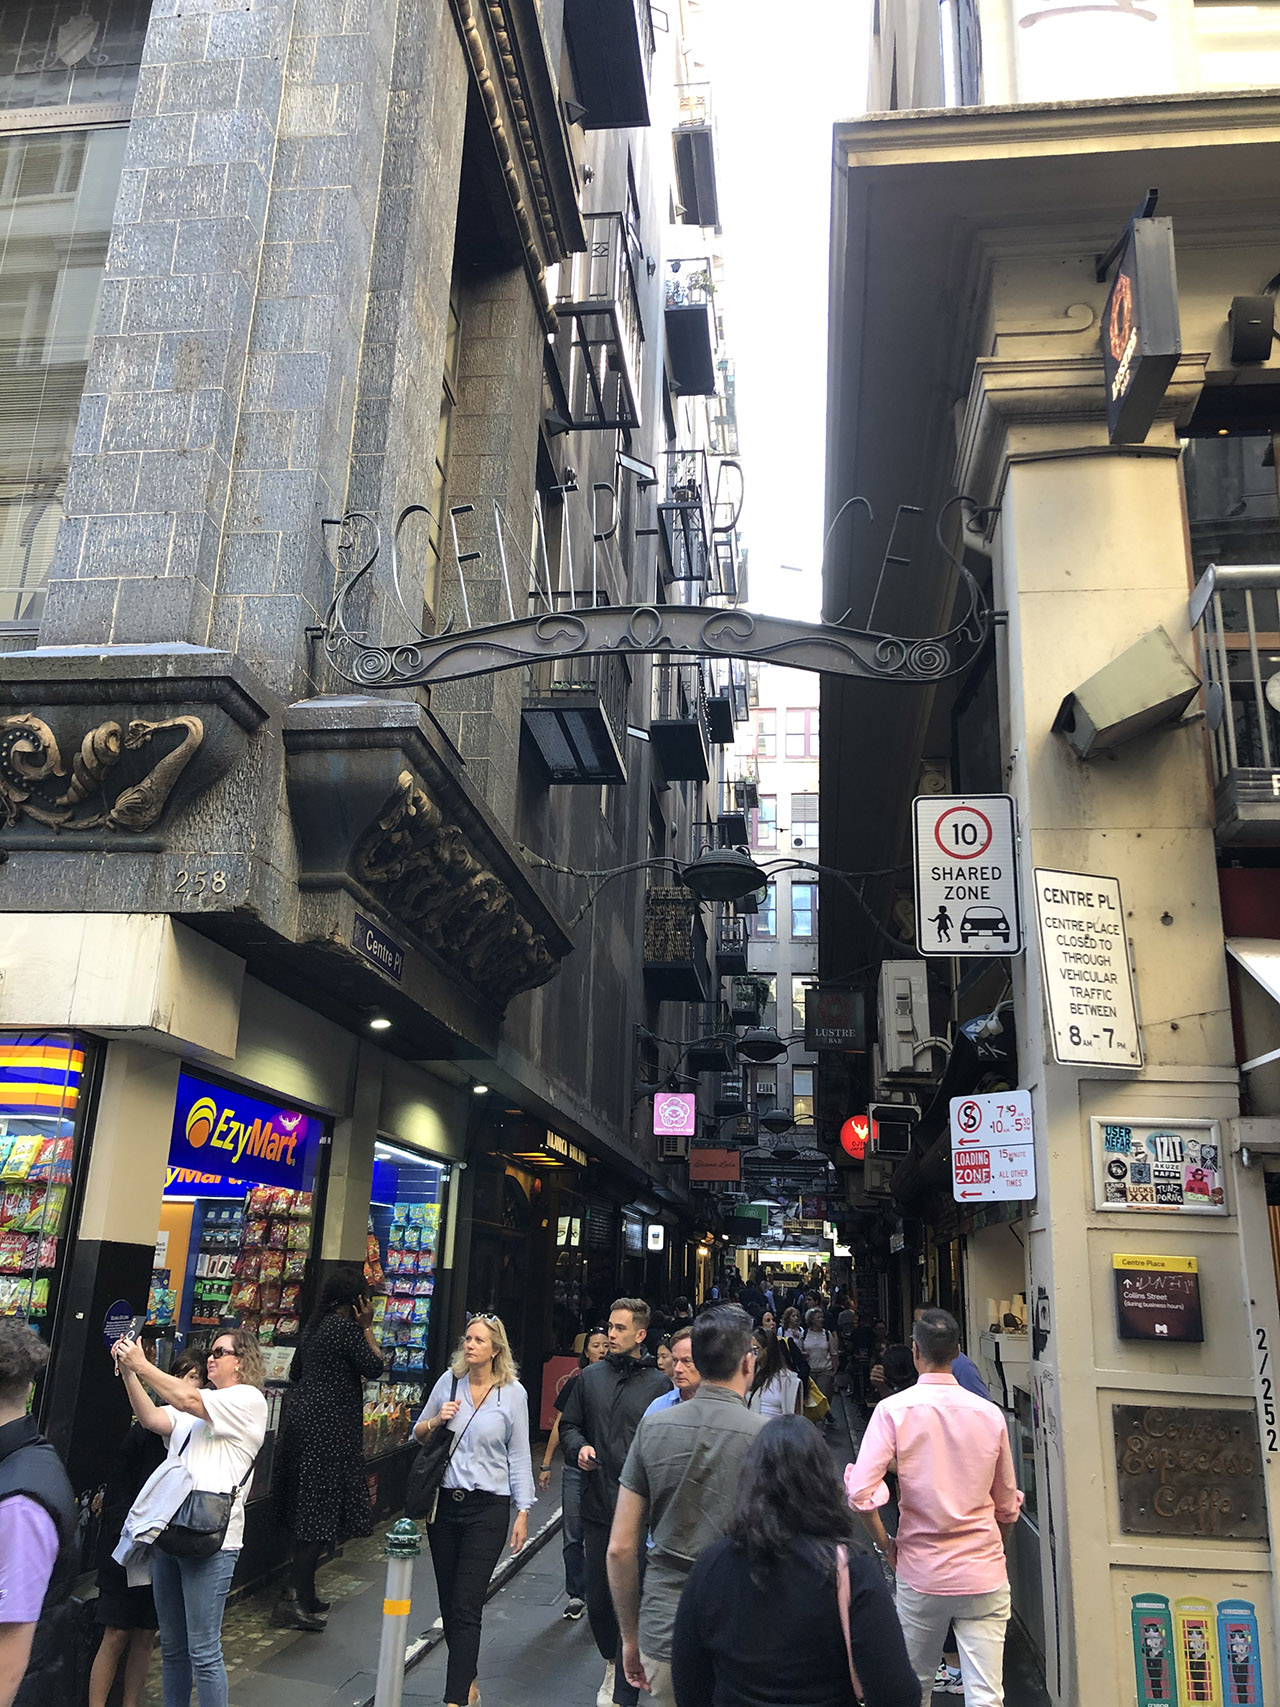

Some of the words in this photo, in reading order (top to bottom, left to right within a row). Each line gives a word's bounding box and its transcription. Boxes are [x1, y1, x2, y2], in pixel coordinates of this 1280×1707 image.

[392, 477, 659, 638] CENTRE
[701, 459, 925, 632] PCE
[952, 823, 978, 846] 10
[931, 867, 1002, 882] SHARED
[173, 870, 227, 895] 258
[944, 886, 991, 900] ZONE
[1043, 887, 1094, 907] CENTRE
[1098, 893, 1115, 910] PL
[1045, 917, 1084, 932] CENTRE
[1086, 921, 1120, 935] PLACE
[1056, 934, 1097, 949] CLOSED
[1099, 939, 1112, 951] TO
[365, 929, 392, 967] Centre
[394, 952, 402, 975] Pl
[1062, 951, 1111, 966] THROUGH
[1059, 968, 1118, 984] VEHICULAR
[1069, 986, 1112, 1000] TRAFFIC
[1069, 1003, 1117, 1018] BETWEEN
[815, 1028, 856, 1037] LUSTRE
[210, 1108, 297, 1165] EzyMart
[1105, 1125, 1132, 1138] USER
[1105, 1136, 1131, 1149] NEFAR
[955, 1151, 989, 1167] LOADING
[955, 1168, 990, 1183] ZONE
[1010, 1170, 1028, 1178] OTHER
[1006, 1179, 1022, 1187] TIMES
[1157, 1192, 1183, 1202] PORNO
[1123, 1291, 1145, 1299] Collins
[1124, 1300, 1142, 1308] (during
[1167, 1302, 1184, 1310] hours)
[1256, 1328, 1278, 1452] 2/252
[1122, 1436, 1255, 1484] Espresso
[1153, 1485, 1231, 1532] Caffe
